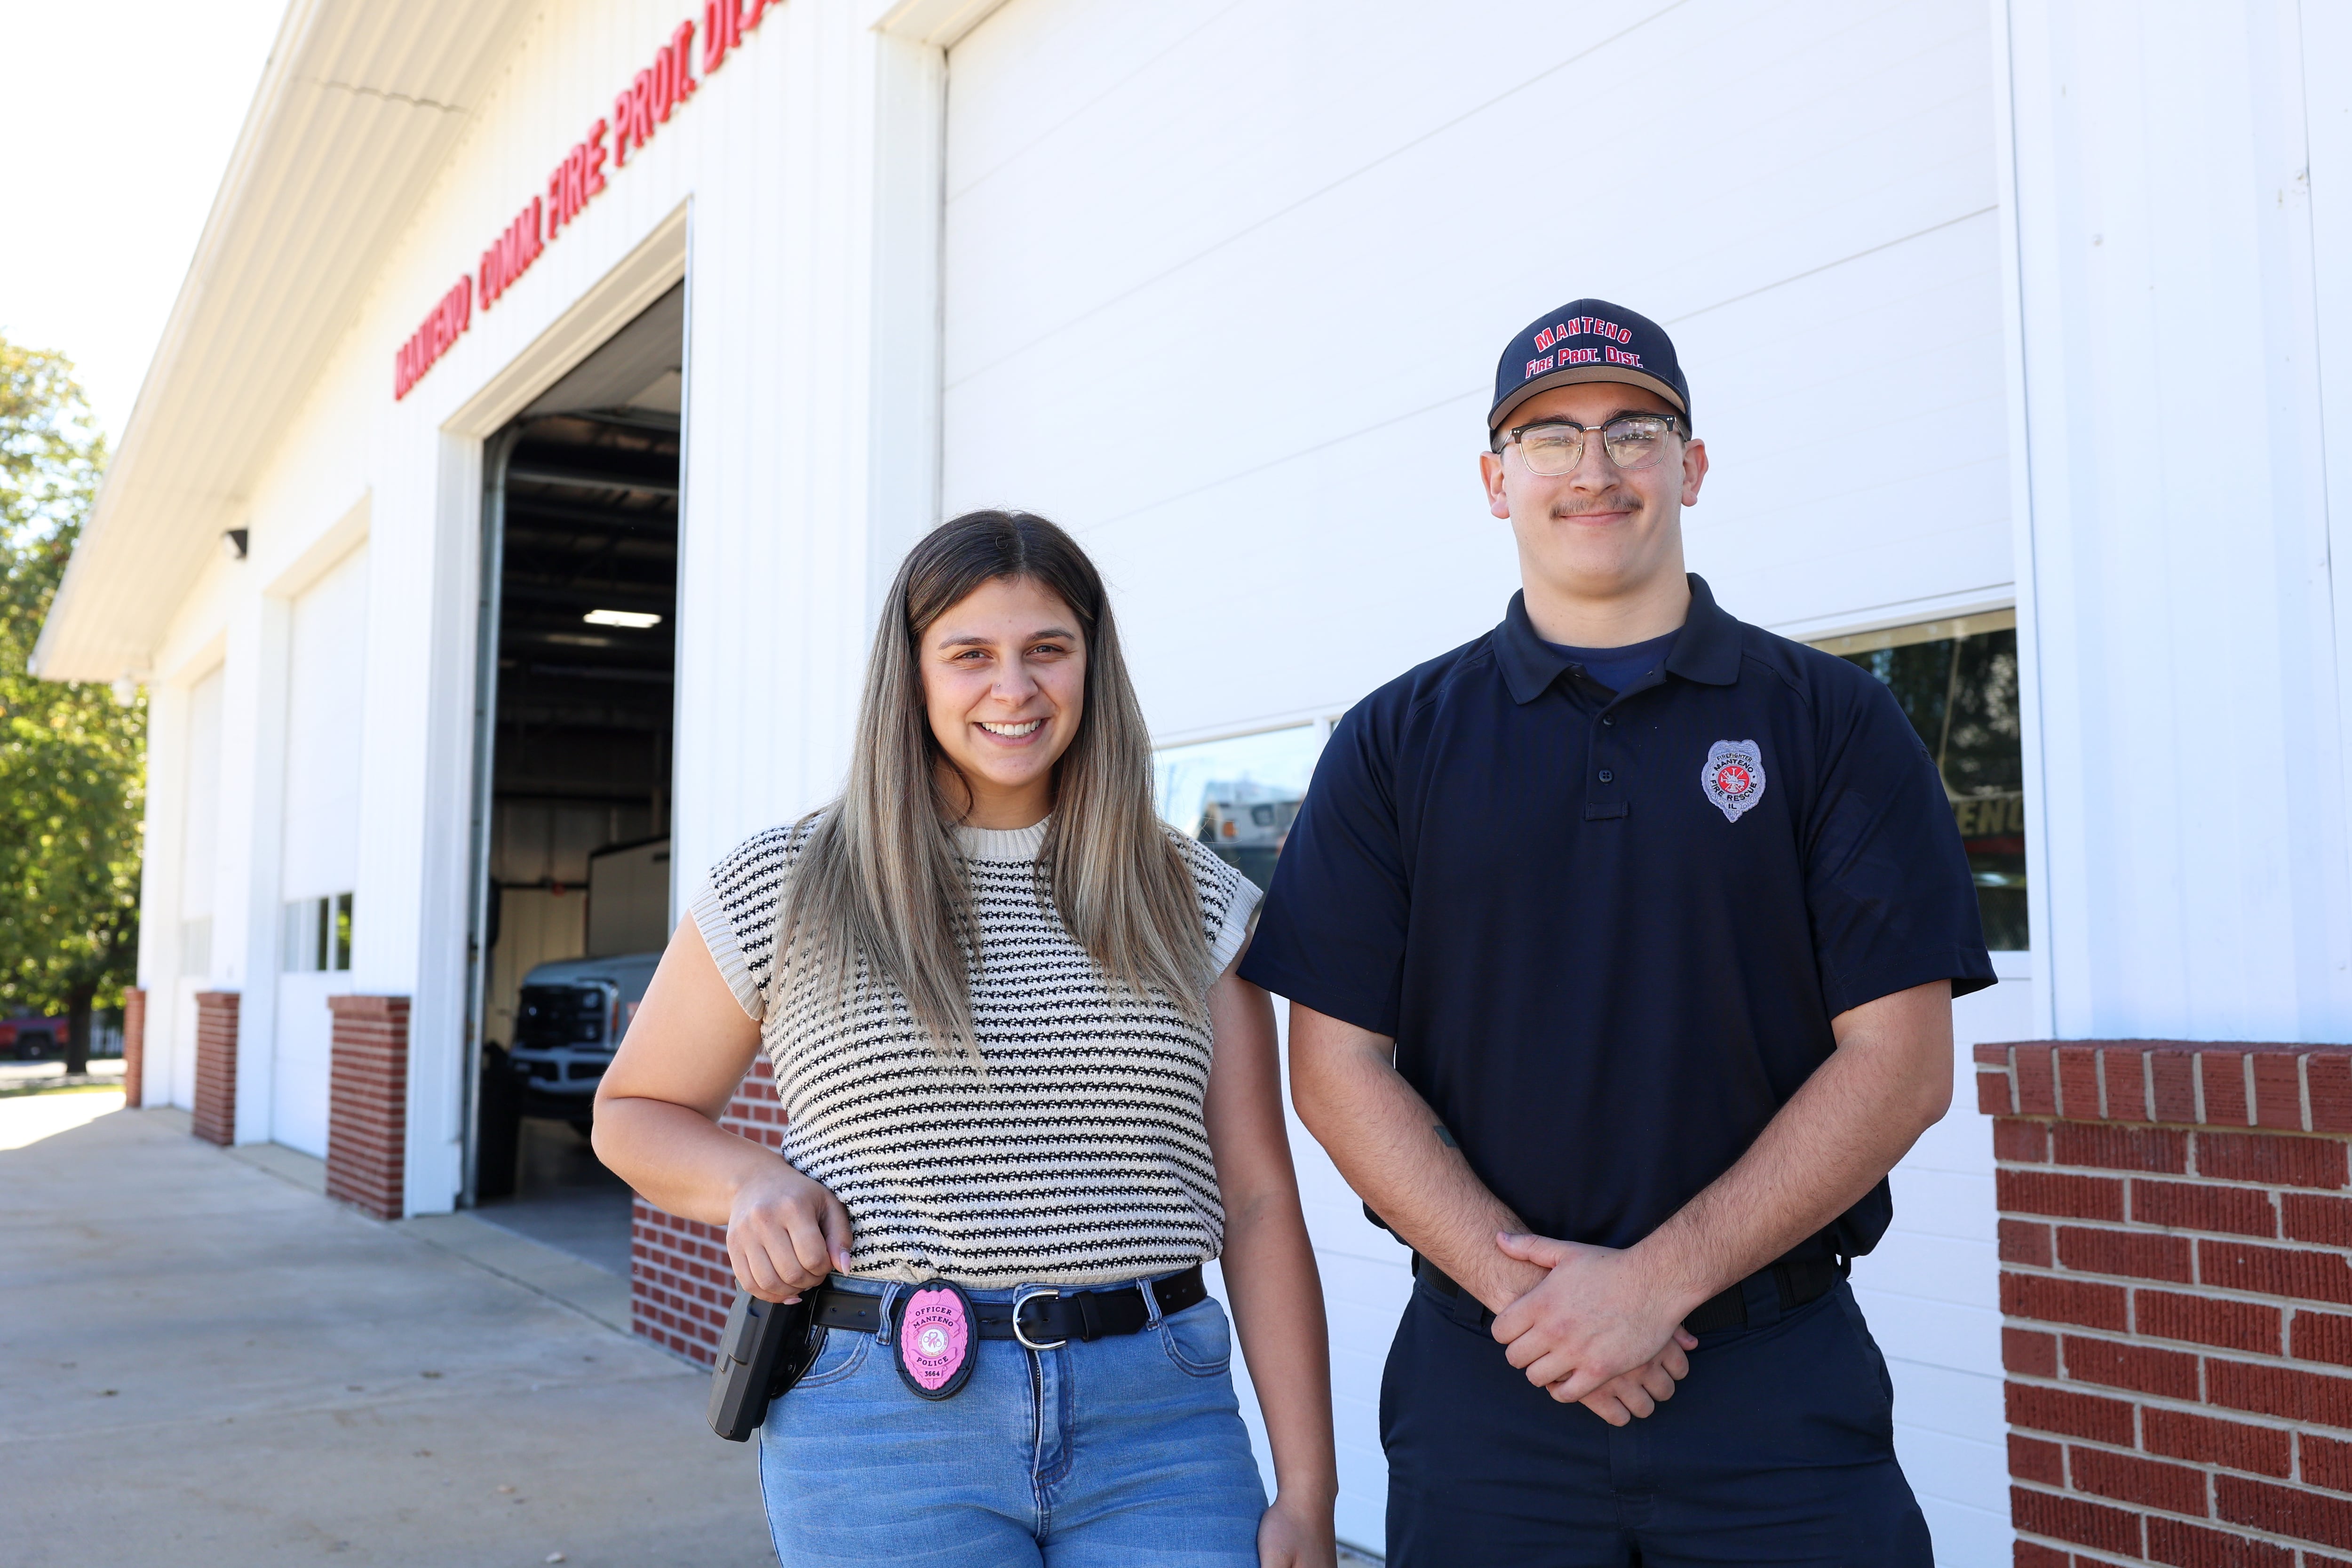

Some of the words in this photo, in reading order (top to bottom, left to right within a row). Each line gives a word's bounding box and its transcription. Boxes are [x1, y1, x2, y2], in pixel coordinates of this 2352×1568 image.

[547, 119, 608, 240] FIRE
[614, 21, 696, 167] PROT.
[1534, 317, 1632, 352] MANTENO
[1526, 356, 1553, 379] FIRE
[1558, 348, 1601, 366] PROT.
[1605, 346, 1643, 368] DIST.
[1713, 759, 1754, 772] MANTENO
[1710, 780, 1724, 796] FIRE
[1727, 783, 1757, 801] RESCUE
[915, 1306, 952, 1316] OFFICER
[913, 1316, 954, 1329] MANTENO
[916, 1356, 948, 1366] POLICE
